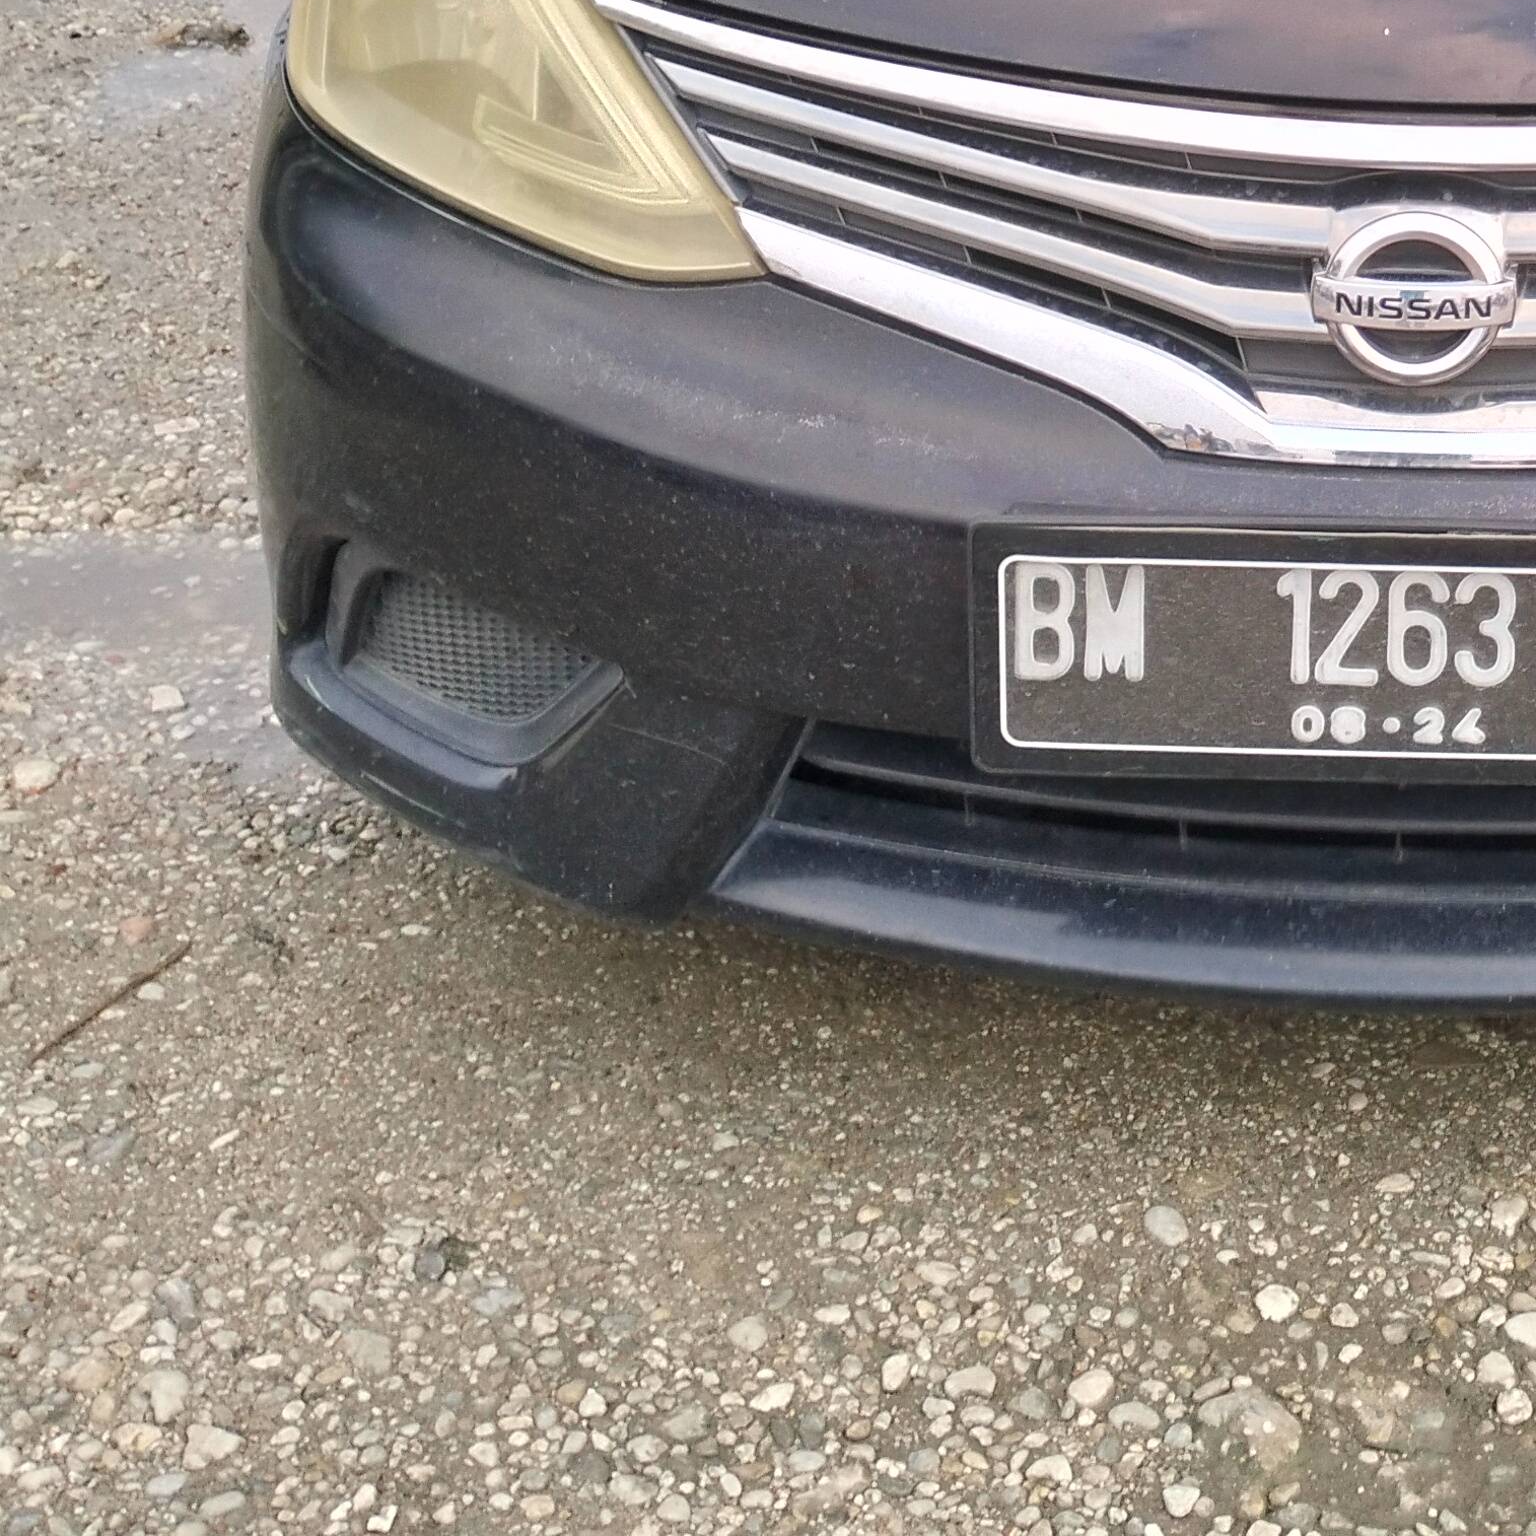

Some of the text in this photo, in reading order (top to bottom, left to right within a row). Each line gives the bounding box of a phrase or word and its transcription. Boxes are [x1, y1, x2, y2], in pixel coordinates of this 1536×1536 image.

[1336, 292, 1493, 320] NISSAN
[1014, 563, 1144, 681] BM
[1277, 568, 1516, 687] 1263
